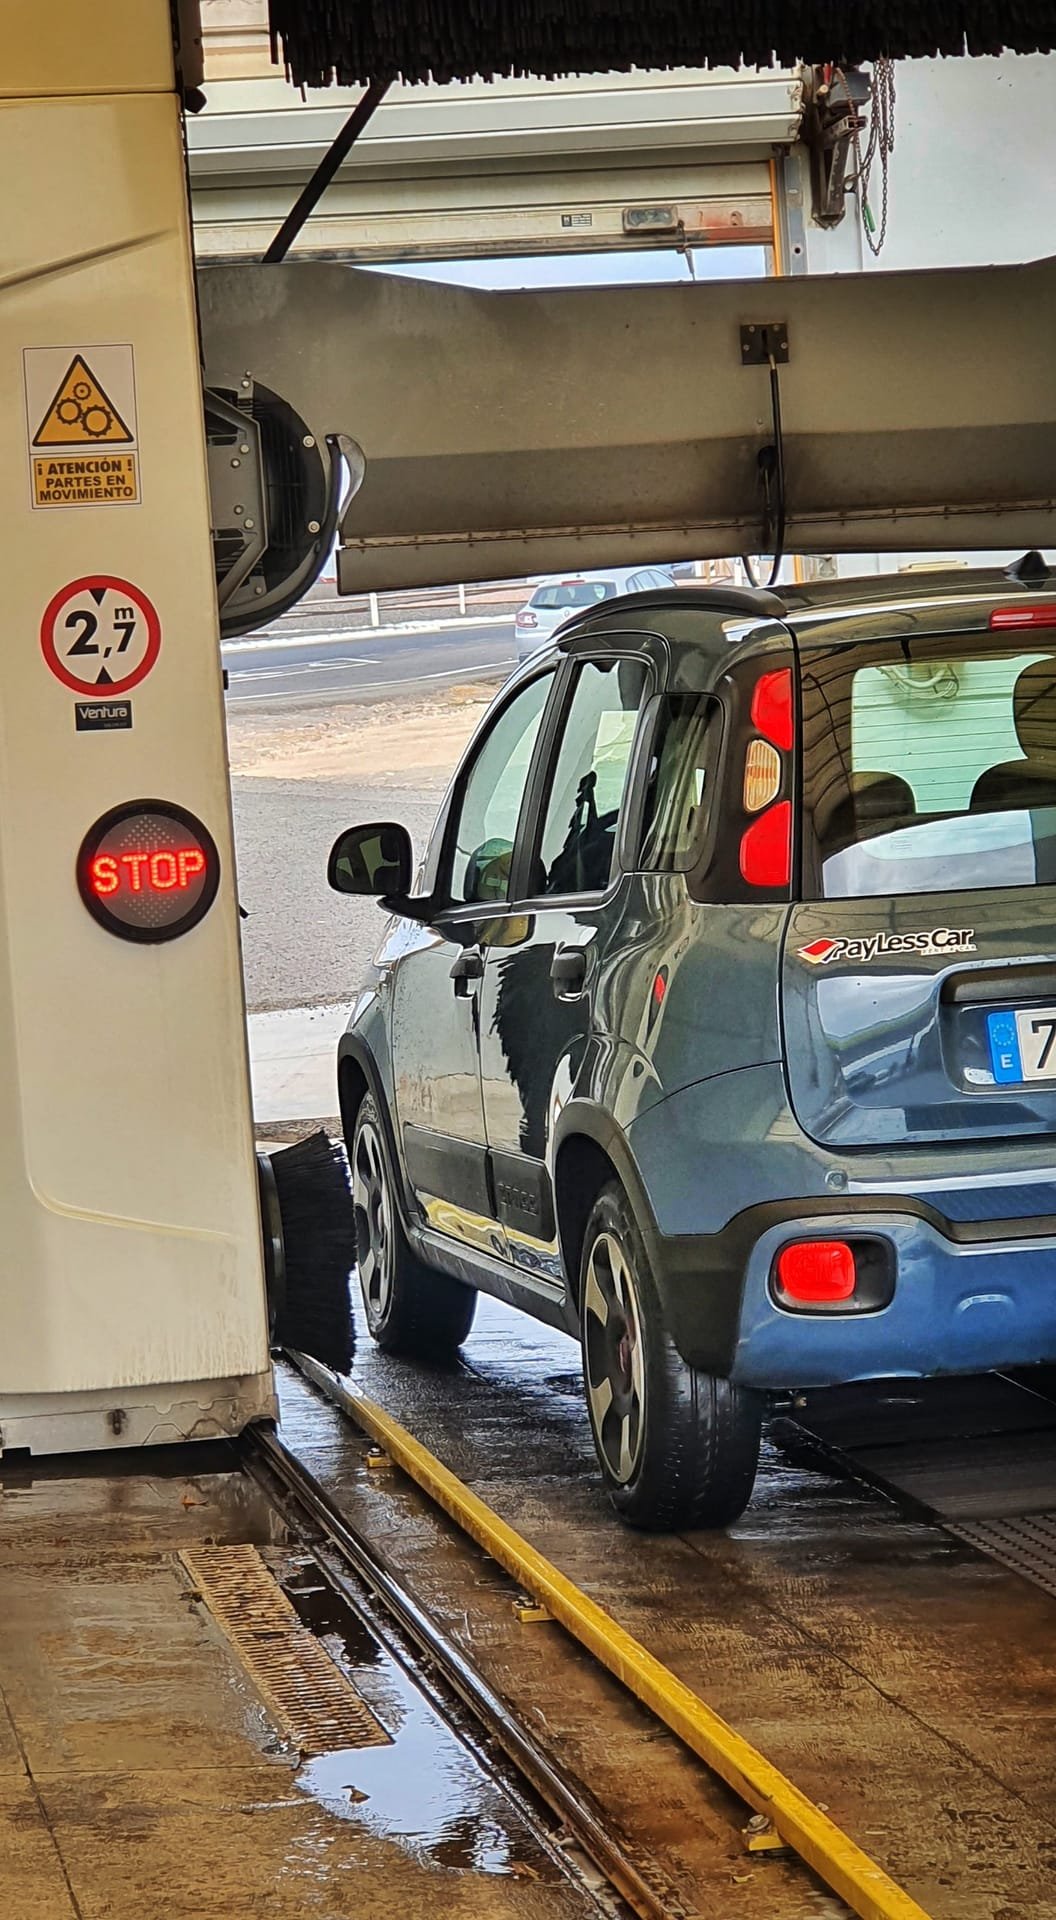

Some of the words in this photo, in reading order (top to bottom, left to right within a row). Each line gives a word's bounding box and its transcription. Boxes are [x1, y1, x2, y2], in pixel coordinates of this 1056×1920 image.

[47, 457, 122, 475] ATENCIÓN
[46, 476, 101, 488] PARTES
[106, 474, 126, 486] EN
[39, 486, 133, 501] MOVIMIENTO
[114, 607, 134, 620] m
[65, 610, 136, 658] 2,7
[79, 705, 128, 719] Ventura
[93, 848, 205, 893] STOP
[1001, 1053, 1014, 1069] E
